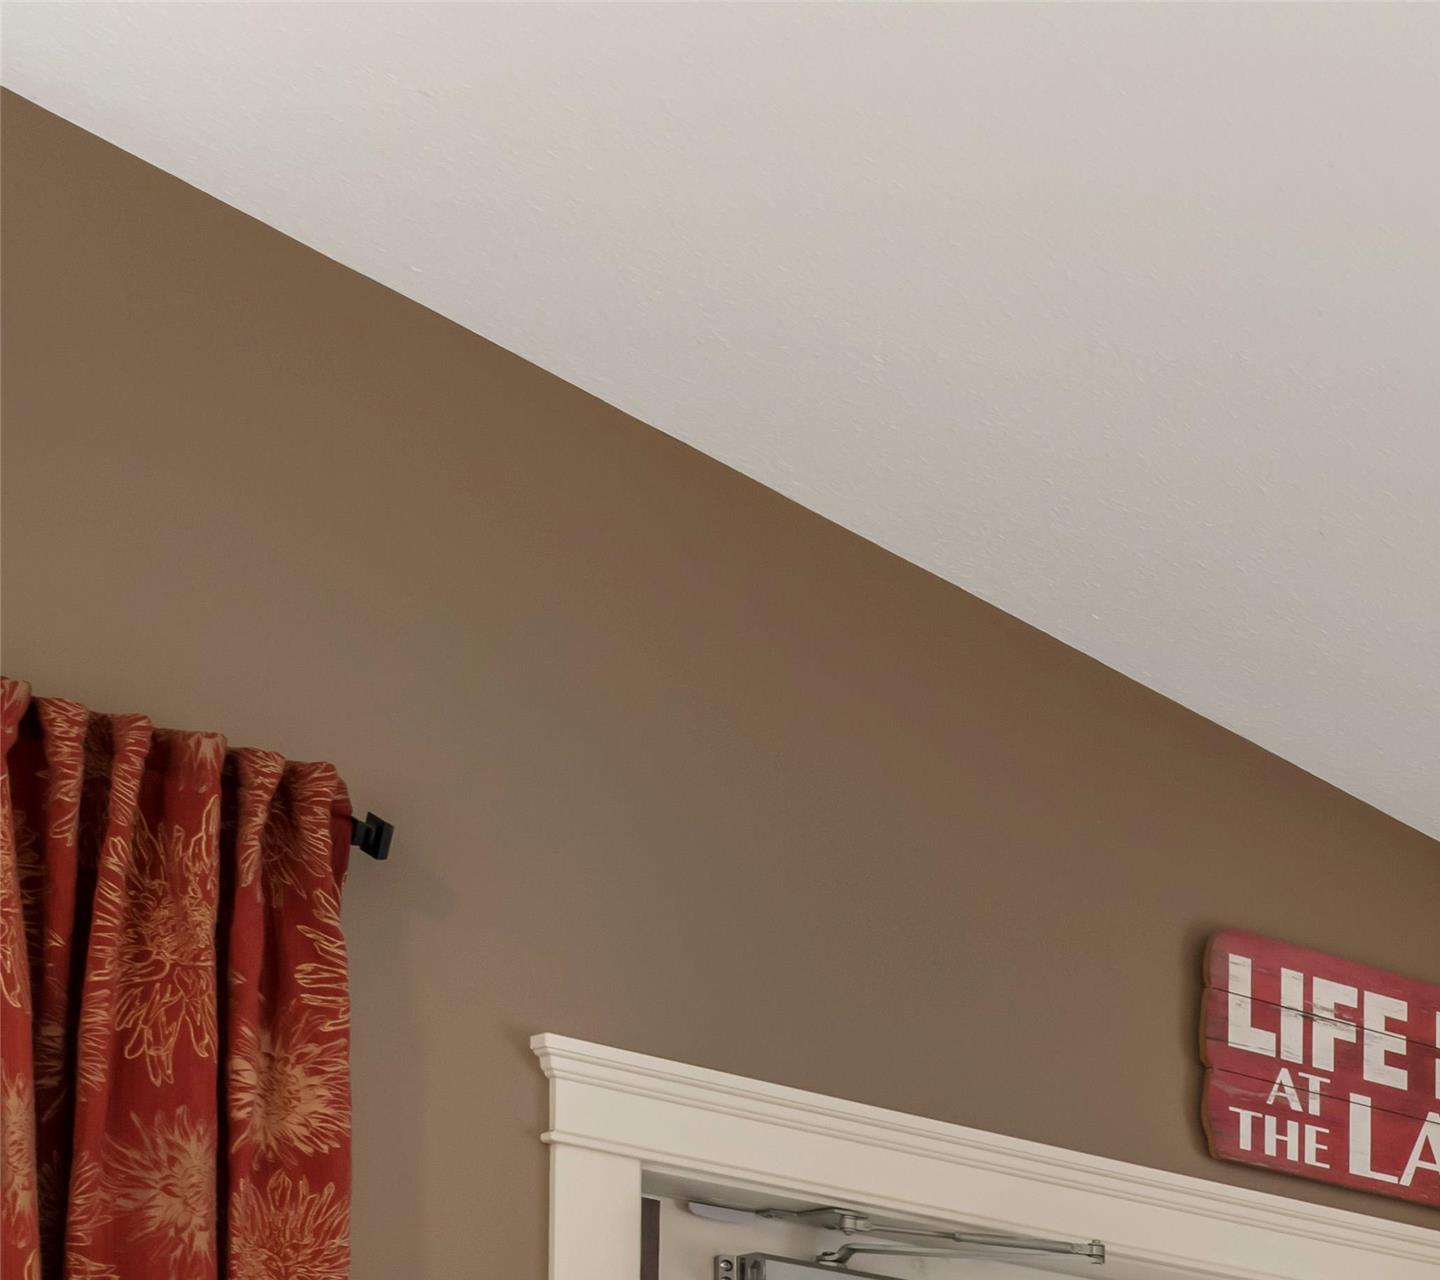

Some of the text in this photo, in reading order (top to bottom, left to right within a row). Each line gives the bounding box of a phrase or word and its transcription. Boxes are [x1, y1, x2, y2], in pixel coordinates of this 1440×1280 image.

[1227, 952, 1409, 1092] LIFE
[1265, 1066, 1332, 1118] AT
[1227, 1105, 1331, 1170] THE
